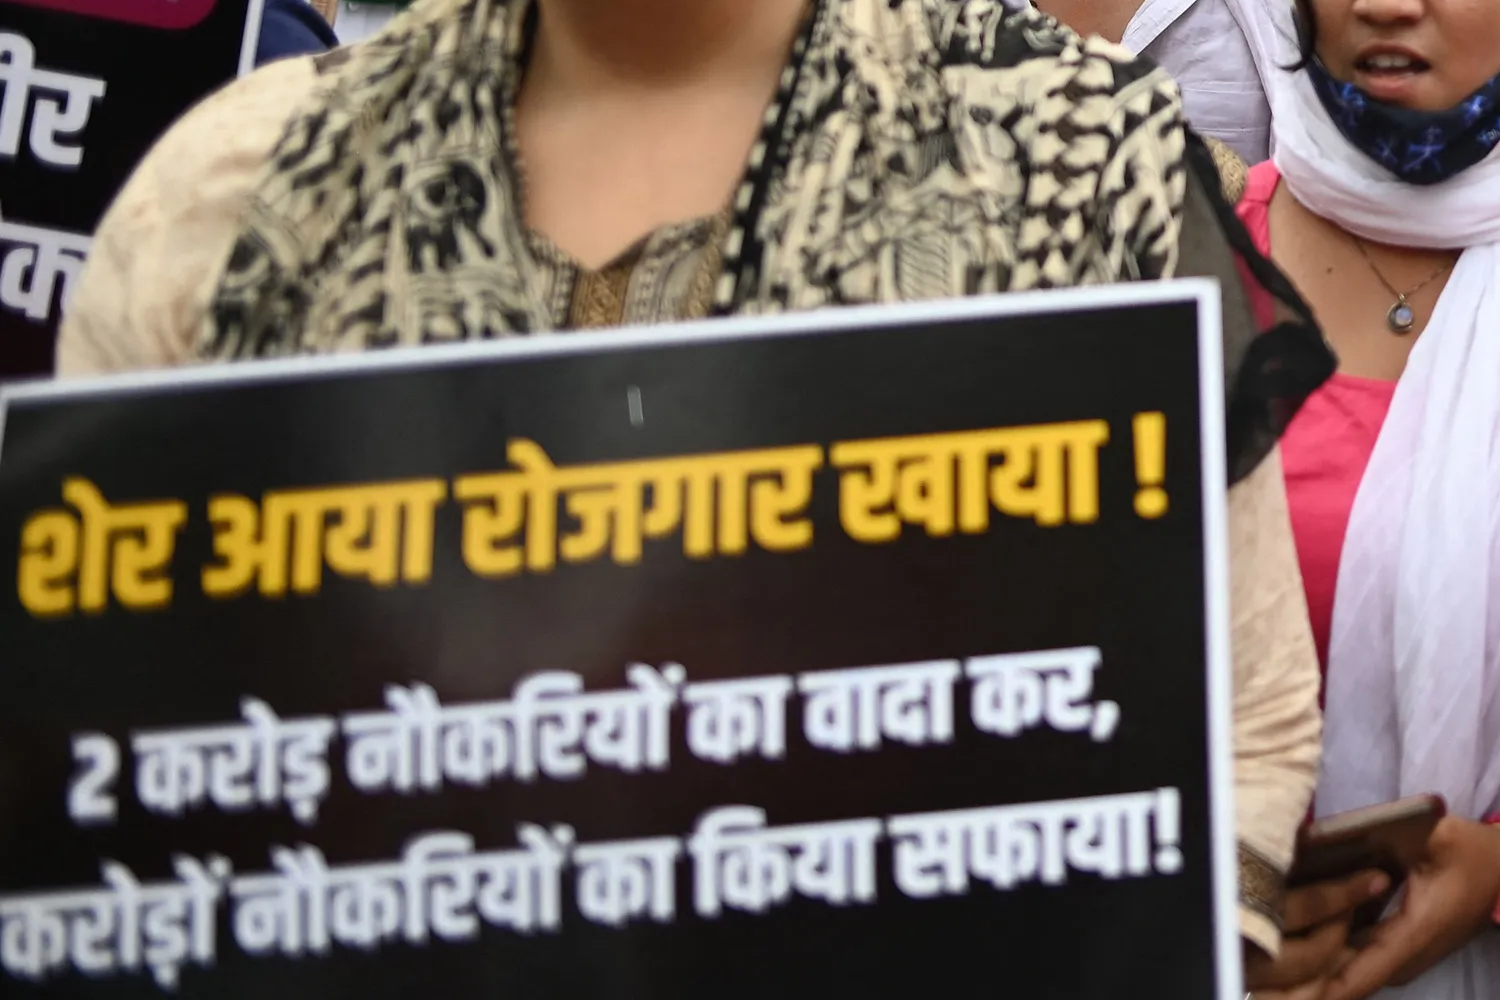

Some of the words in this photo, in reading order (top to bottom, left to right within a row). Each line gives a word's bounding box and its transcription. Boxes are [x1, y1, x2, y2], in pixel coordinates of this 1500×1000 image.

[17, 478, 187, 615] शेर
[202, 476, 448, 596] आया
[453, 438, 825, 578] रोजगार
[829, 419, 1111, 543] खाया
[68, 735, 120, 822] 2
[131, 696, 338, 824] करोड़
[341, 663, 687, 794] नौकरियों
[683, 674, 796, 765] का
[796, 658, 964, 754] वादा
[963, 645, 1121, 743] कर,
[0, 854, 233, 989] करोड़ों
[228, 821, 578, 957] नौकरियों
[572, 835, 685, 927] का
[685, 803, 885, 919] किया
